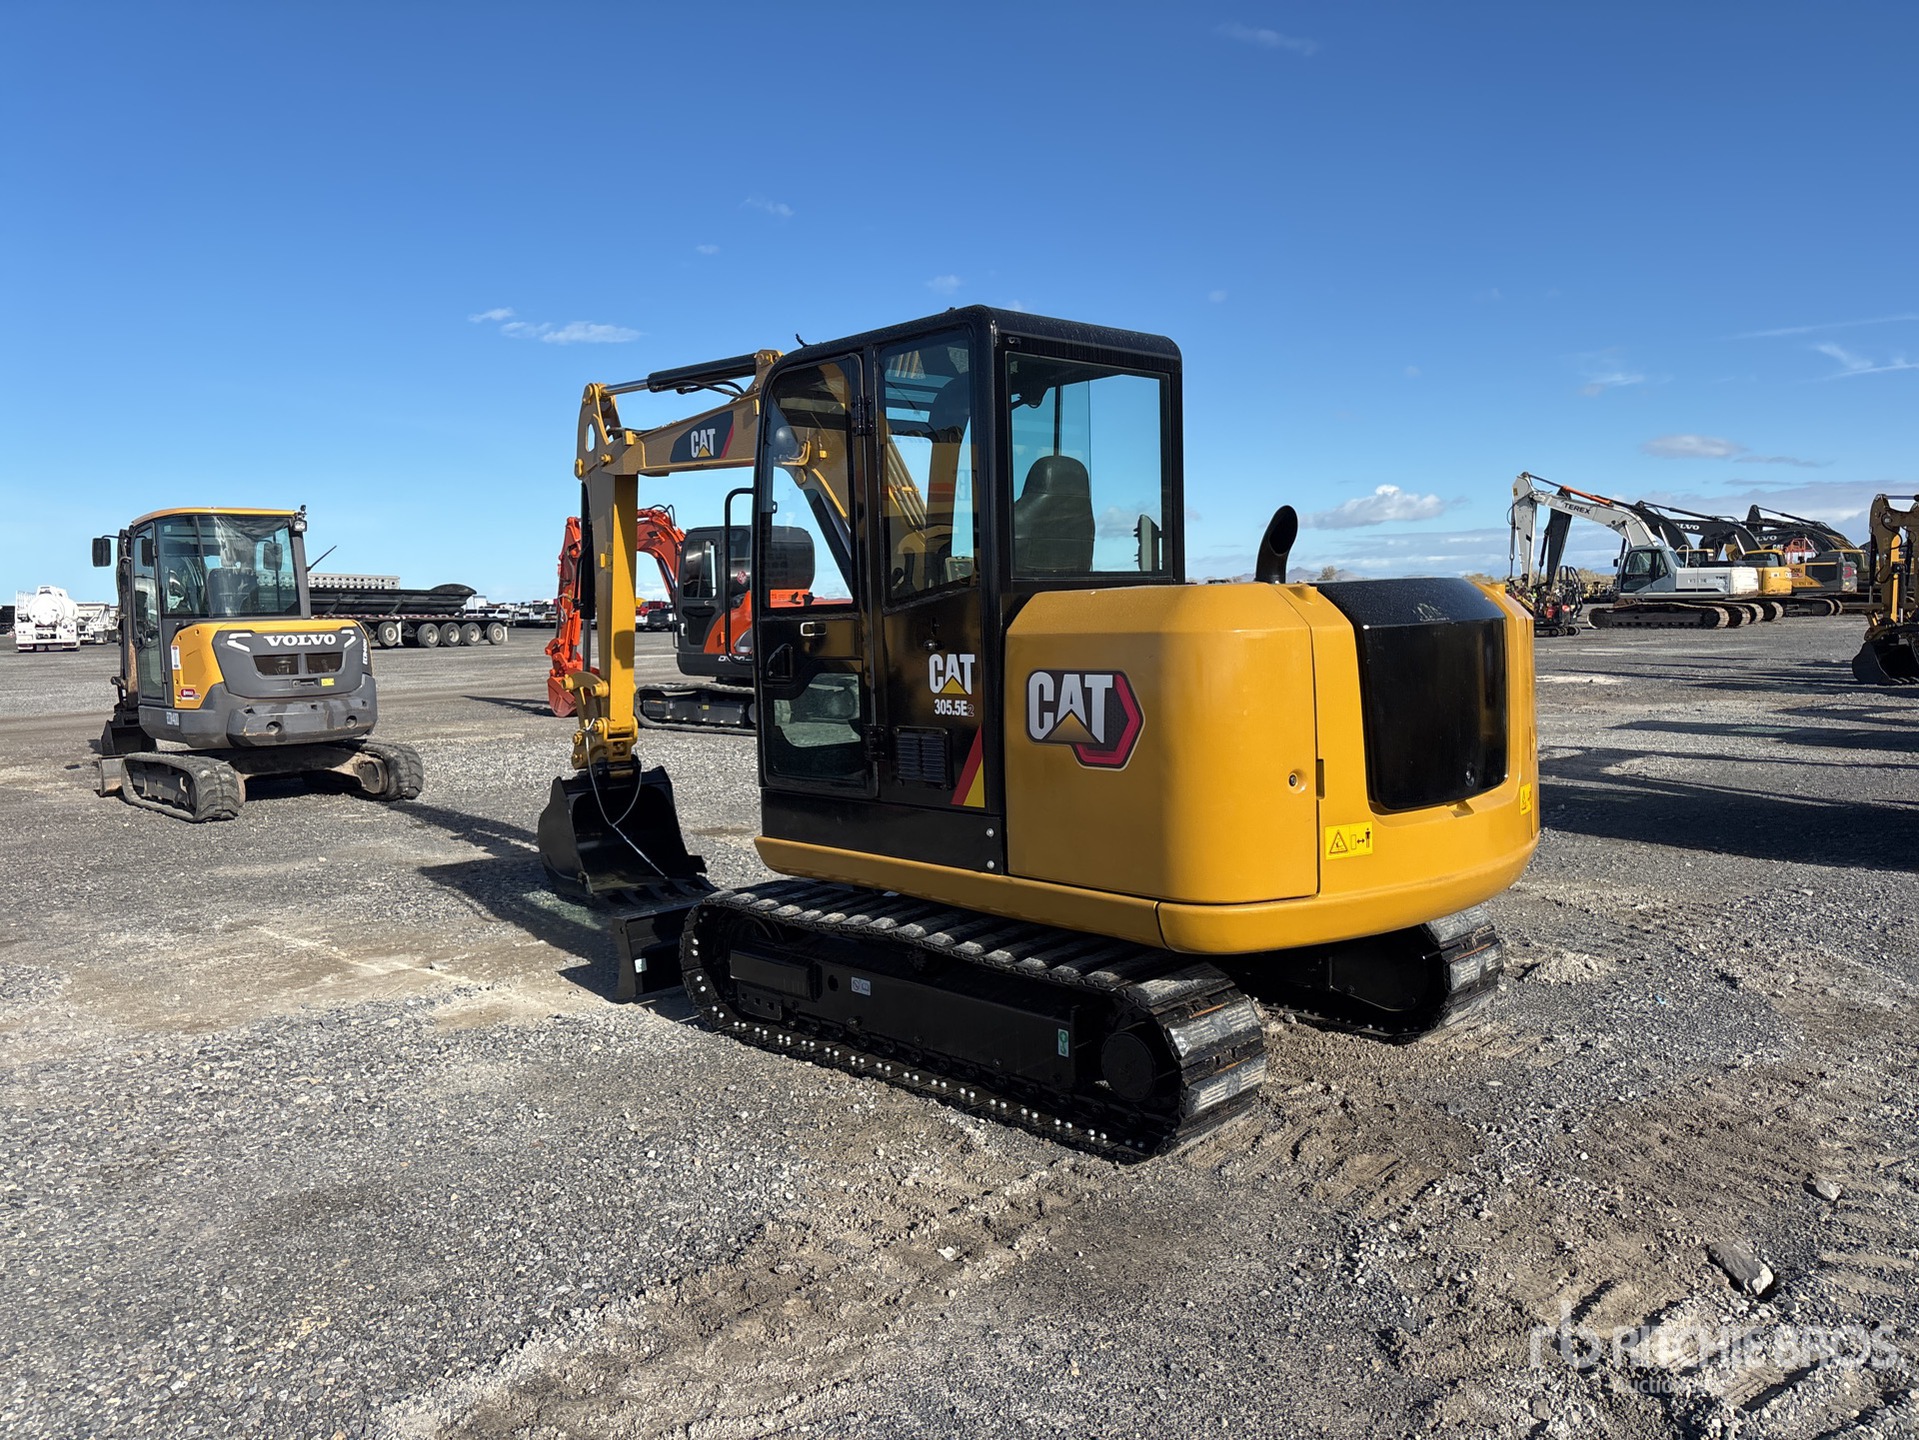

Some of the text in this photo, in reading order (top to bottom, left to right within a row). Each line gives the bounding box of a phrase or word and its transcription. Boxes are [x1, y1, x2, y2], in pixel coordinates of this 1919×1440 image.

[690, 428, 715, 458] CAT
[1563, 502, 1591, 514] TEREX
[1676, 523, 1700, 531] LVO
[263, 634, 337, 647] VOLVO
[929, 653, 975, 695] CAT
[934, 698, 975, 718] 305.5E2
[1028, 671, 1113, 744] CAT
